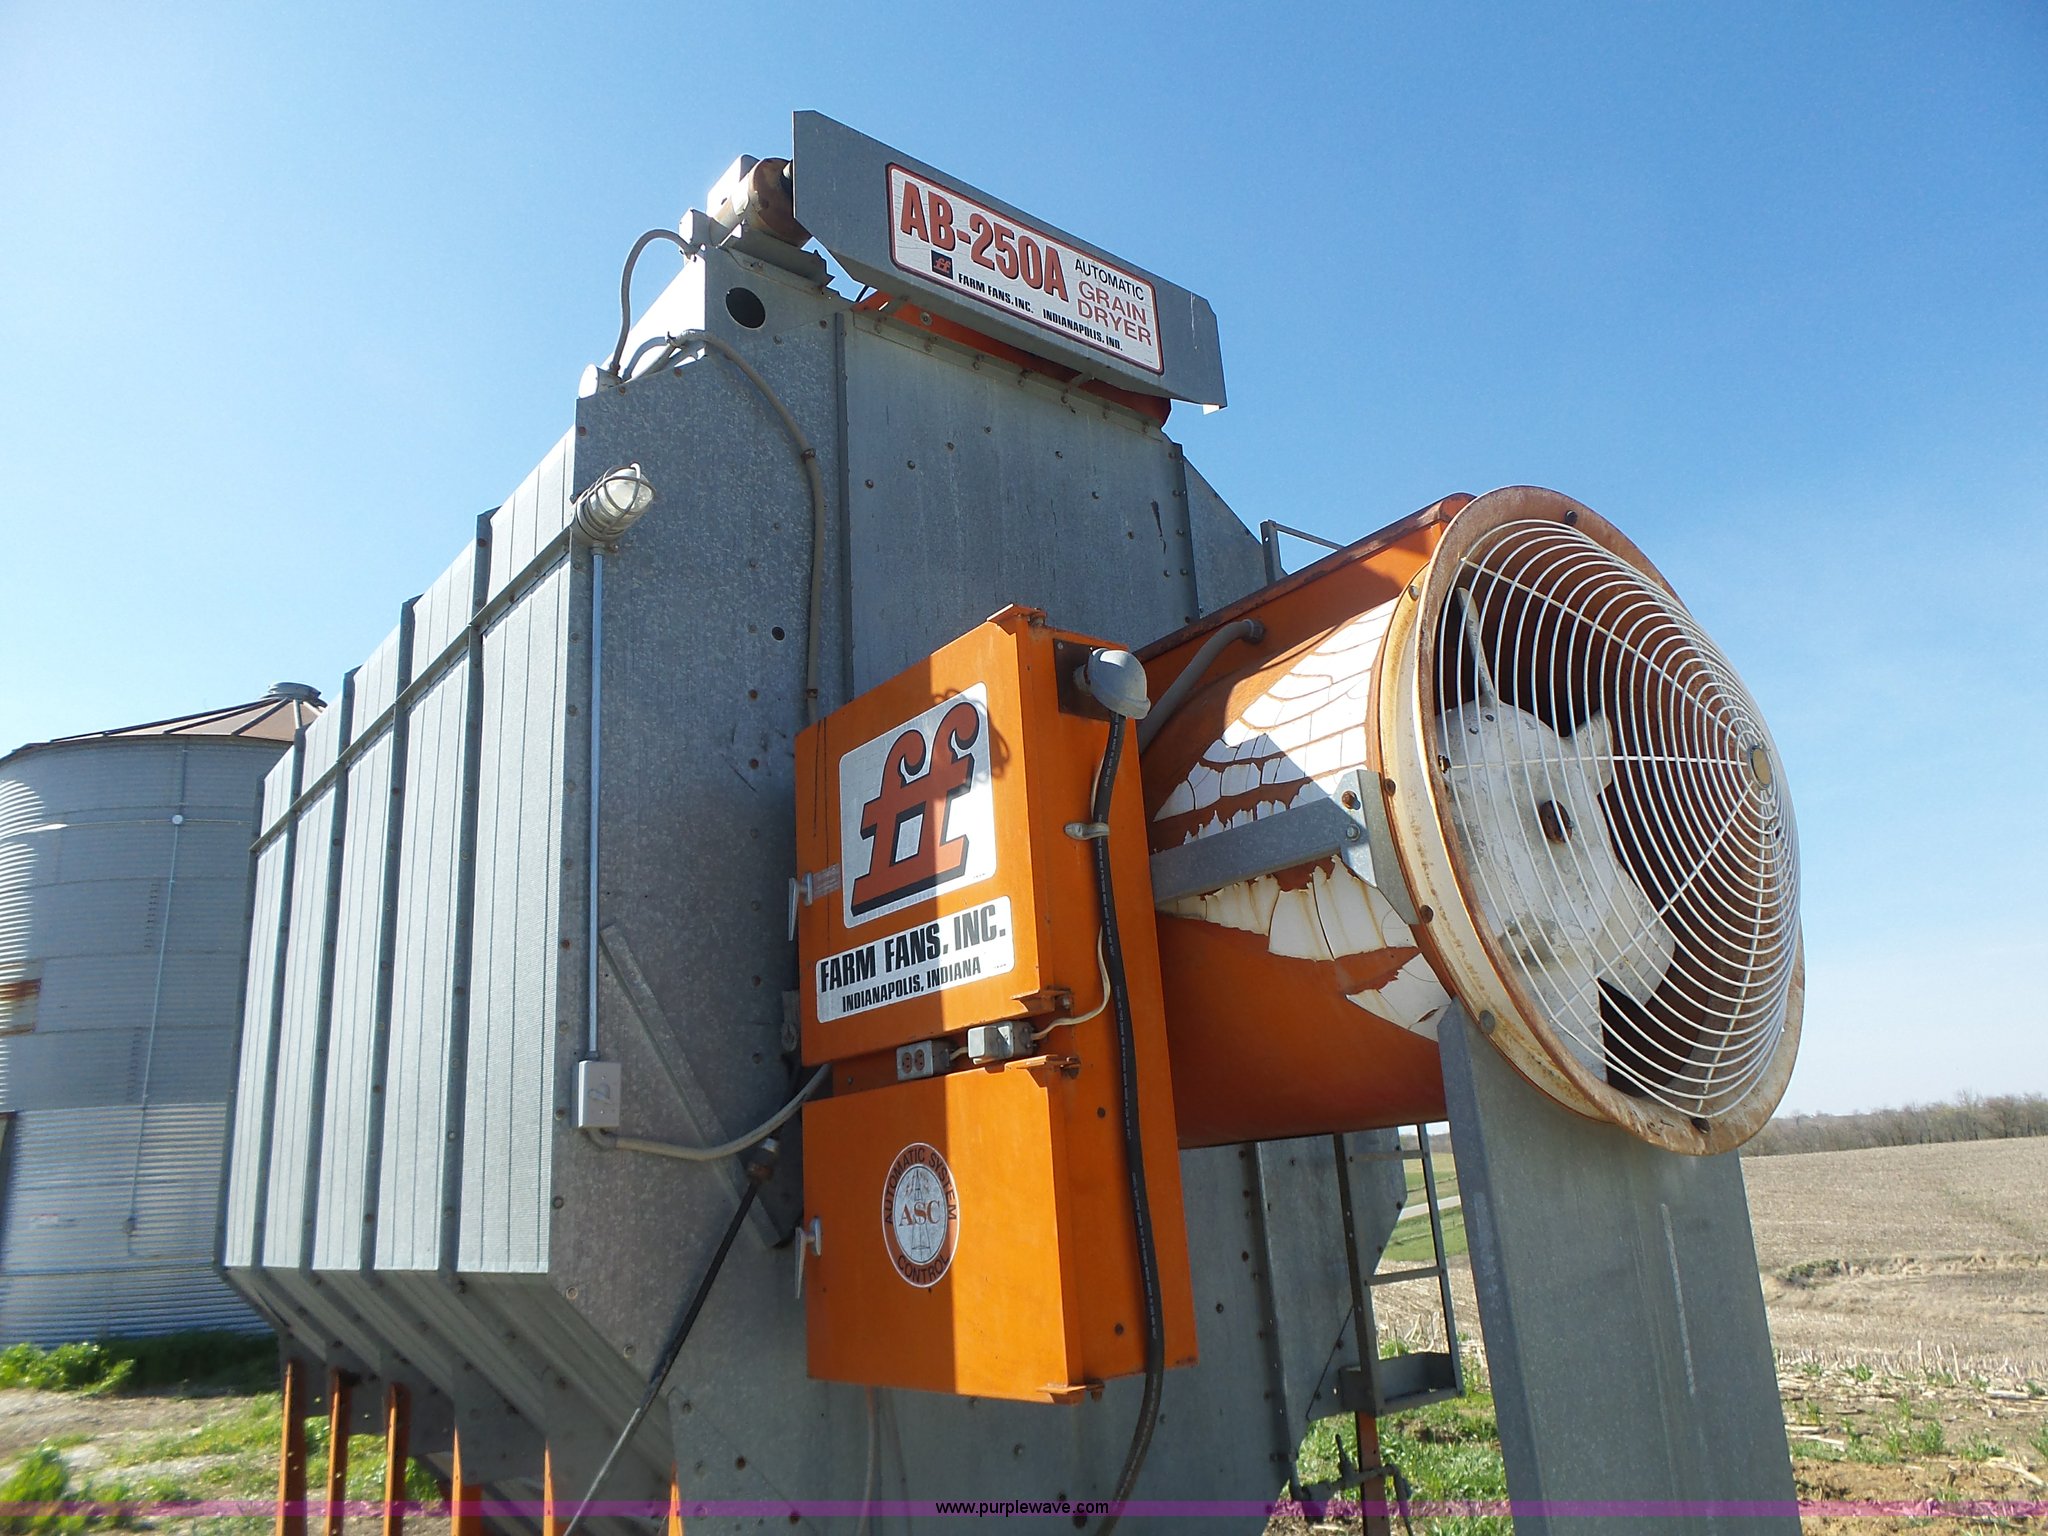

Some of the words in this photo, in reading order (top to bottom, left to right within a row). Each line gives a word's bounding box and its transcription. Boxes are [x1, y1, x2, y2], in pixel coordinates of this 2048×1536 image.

[900, 180, 1069, 302] AB-250A
[958, 273, 986, 293] FARM
[1015, 297, 1034, 314] INC.
[1075, 258, 1145, 301] AUTOMATIC
[1077, 298, 1152, 346] DRYER
[1078, 280, 1147, 326] GRAIN
[1106, 335, 1123, 351] IND.
[821, 944, 876, 993] FARM
[954, 904, 1006, 951] INC.
[842, 974, 924, 1013] INDIANAPOLIS,
[927, 956, 981, 990] INDIANA
[884, 1147, 925, 1225] AUTOMATIC
[929, 1152, 957, 1220] SYSTEM
[898, 1200, 941, 1227] ASC
[897, 1254, 950, 1285] CONTROL
